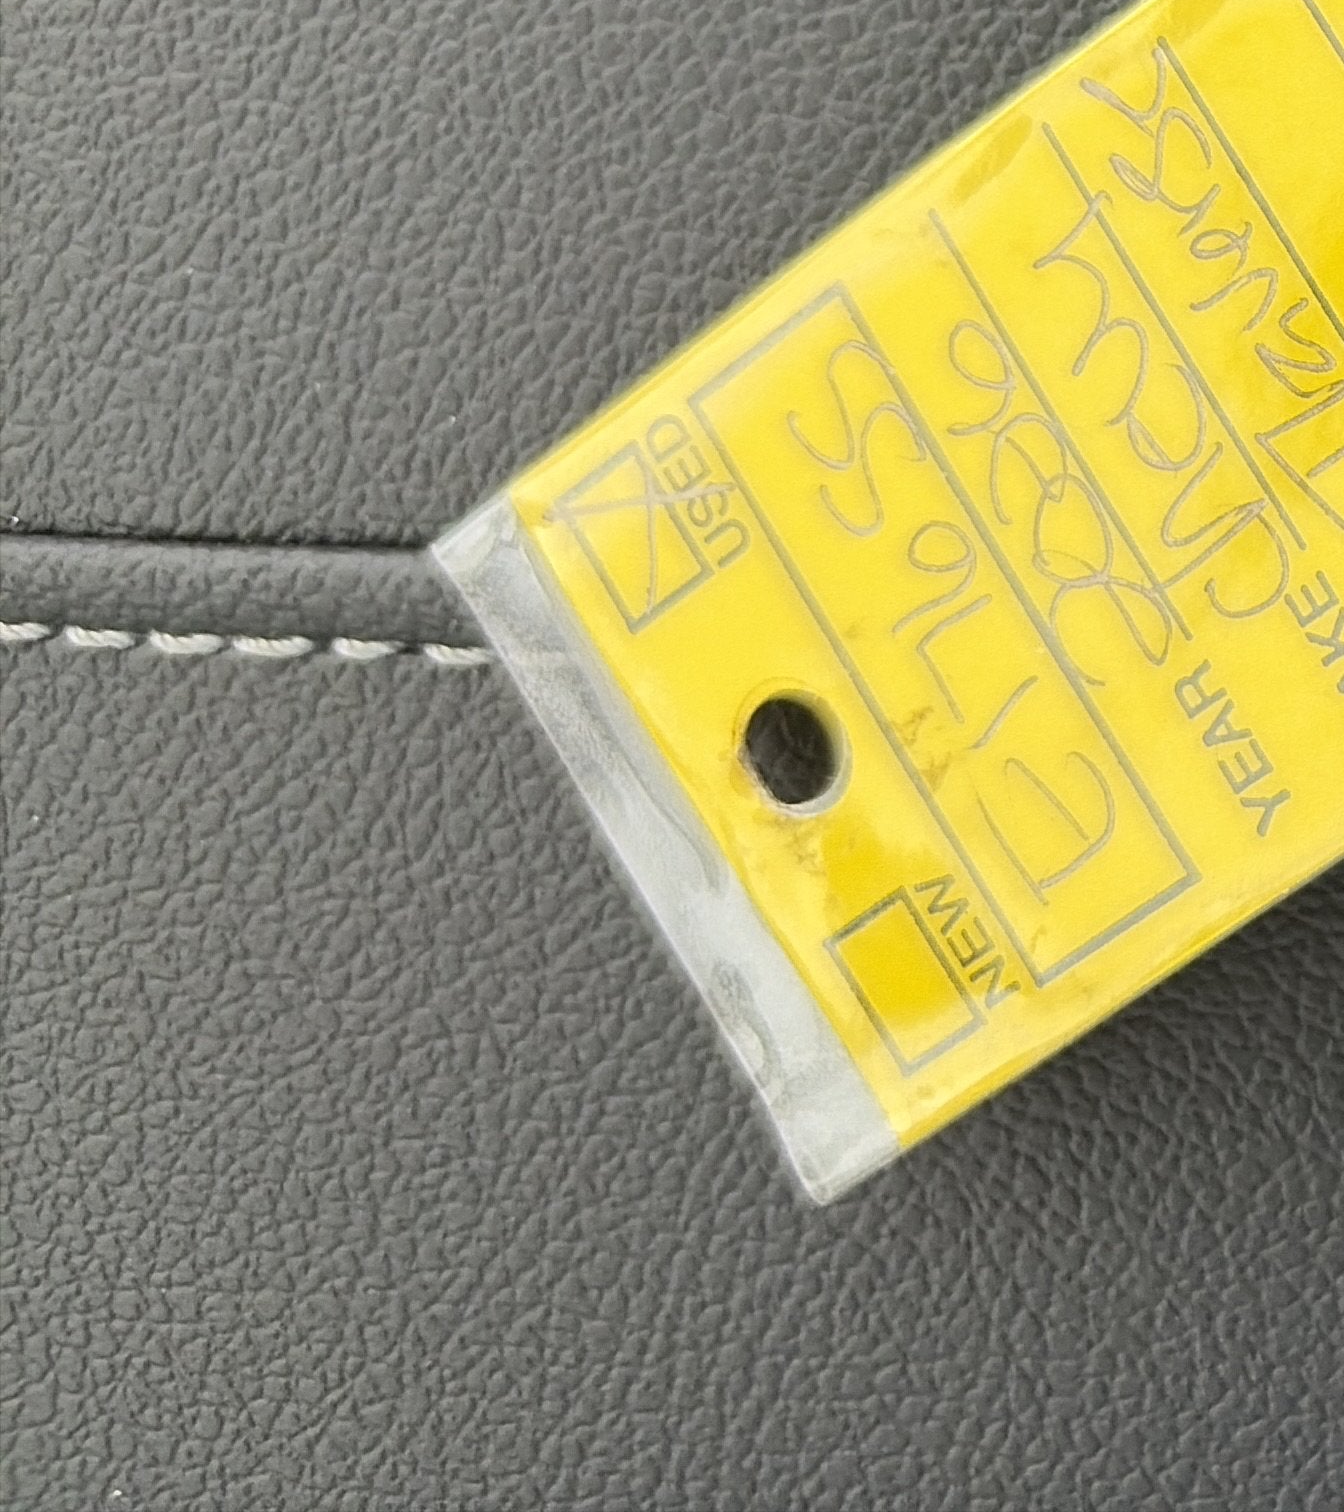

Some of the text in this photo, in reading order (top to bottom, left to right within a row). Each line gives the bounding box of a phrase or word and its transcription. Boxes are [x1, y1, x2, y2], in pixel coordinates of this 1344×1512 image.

[643, 417, 749, 568] USED
[946, 324, 1172, 685] 2026
[1170, 658, 1291, 837] YEAR
[913, 870, 1022, 1009] NEW
